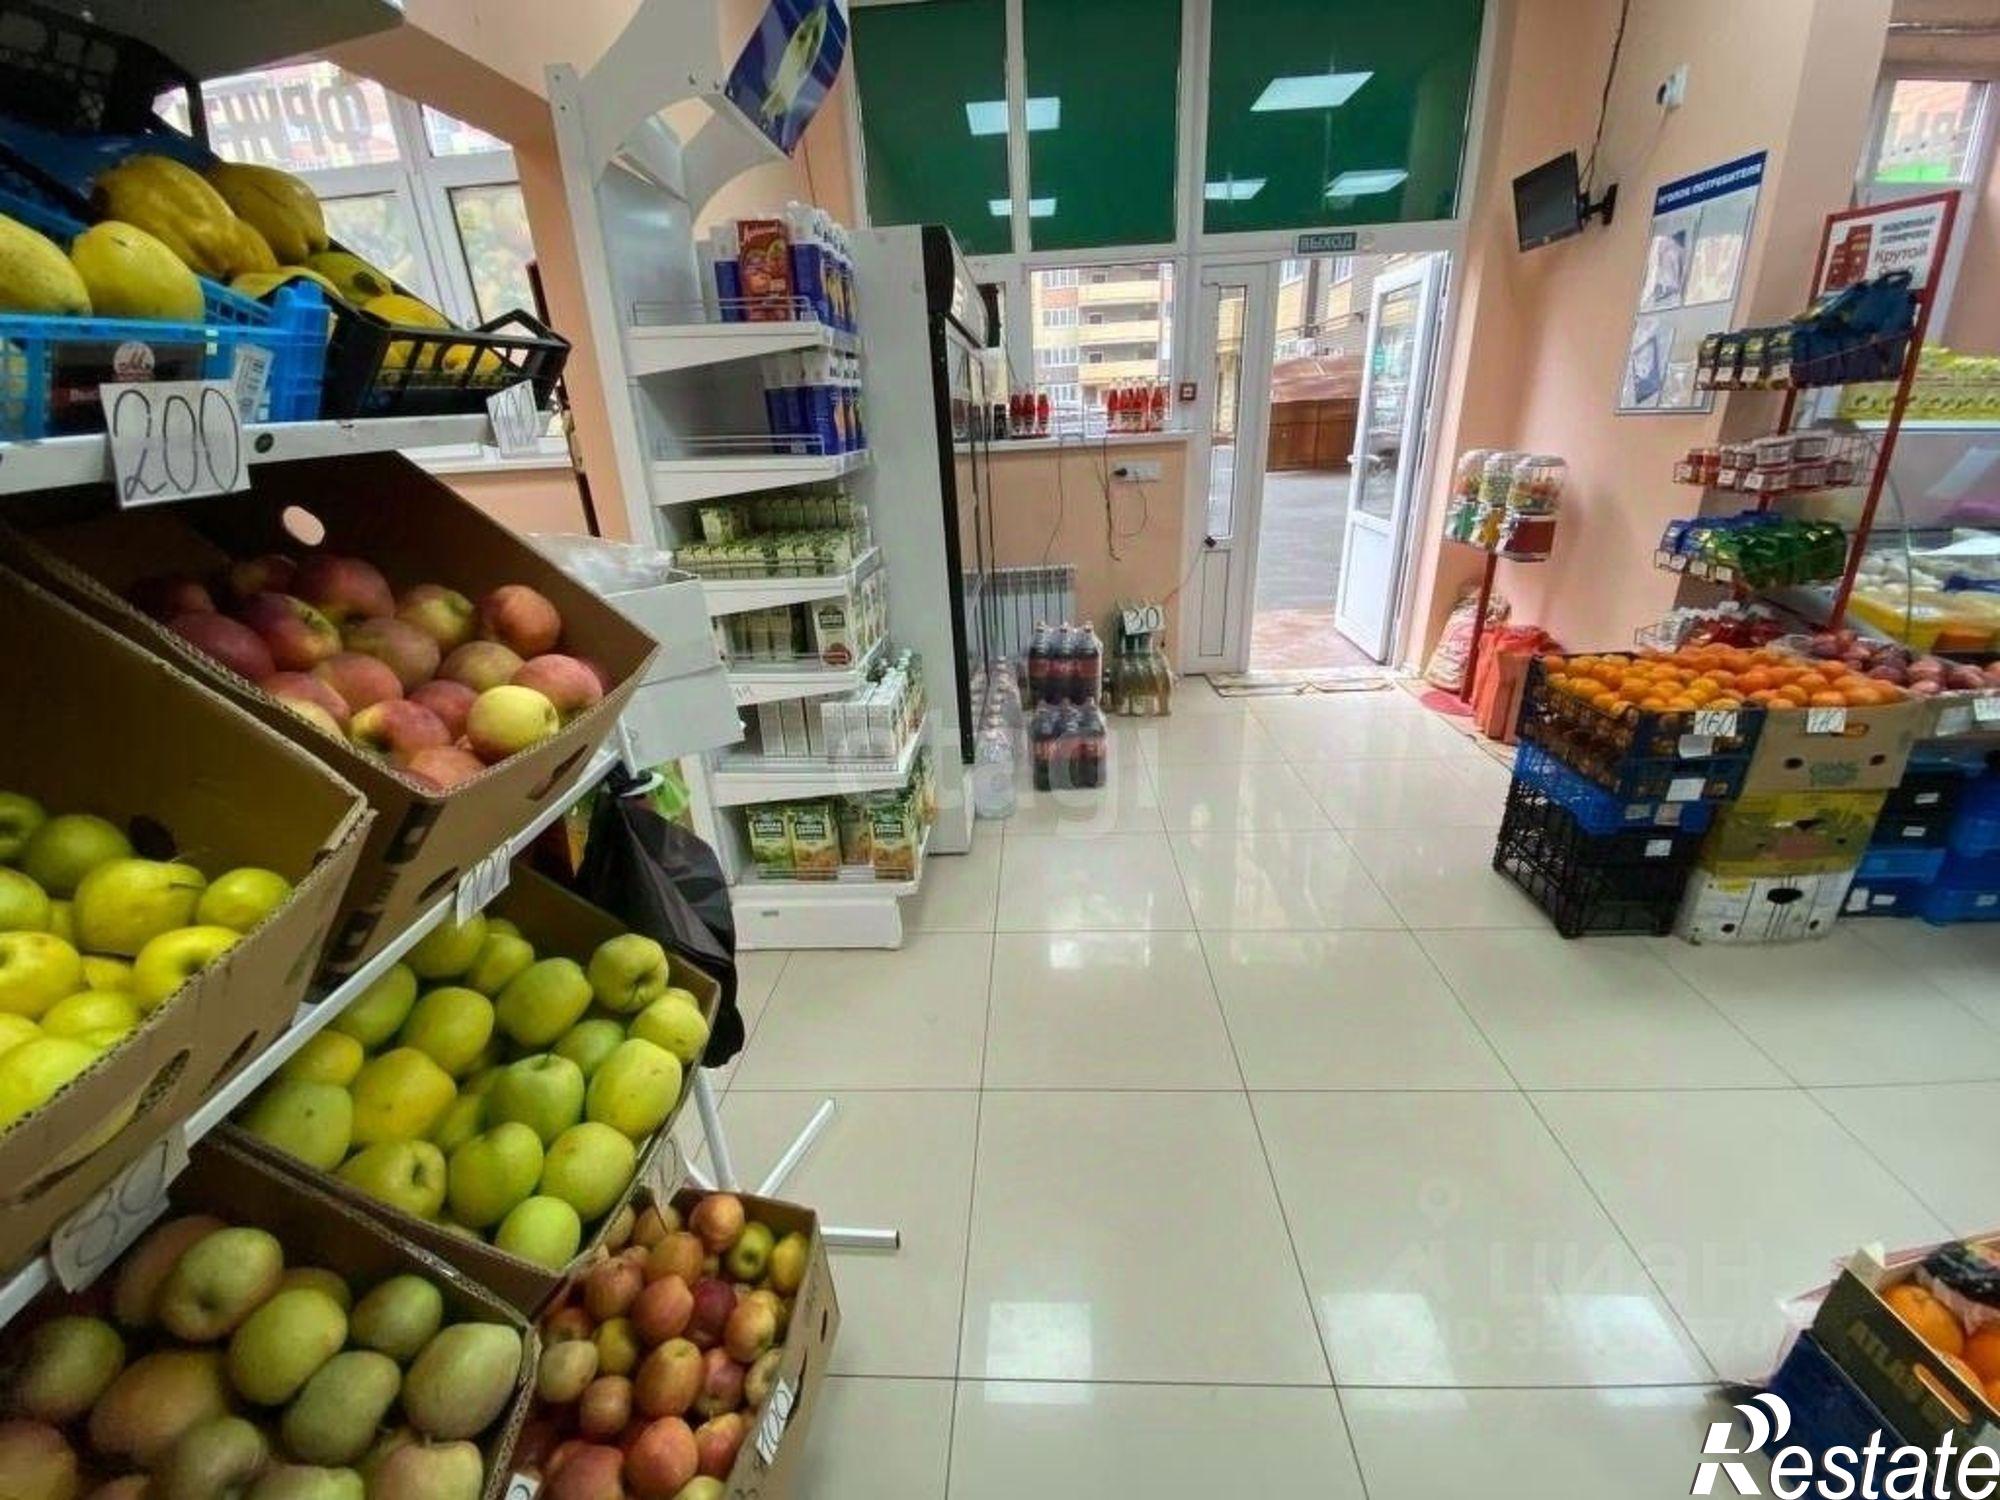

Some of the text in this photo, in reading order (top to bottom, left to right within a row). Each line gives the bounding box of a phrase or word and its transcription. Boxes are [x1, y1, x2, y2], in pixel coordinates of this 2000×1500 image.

[1300, 234, 1354, 252] ВЫХОД
[1875, 242, 1928, 264] Крутой
[113, 388, 239, 500] 200
